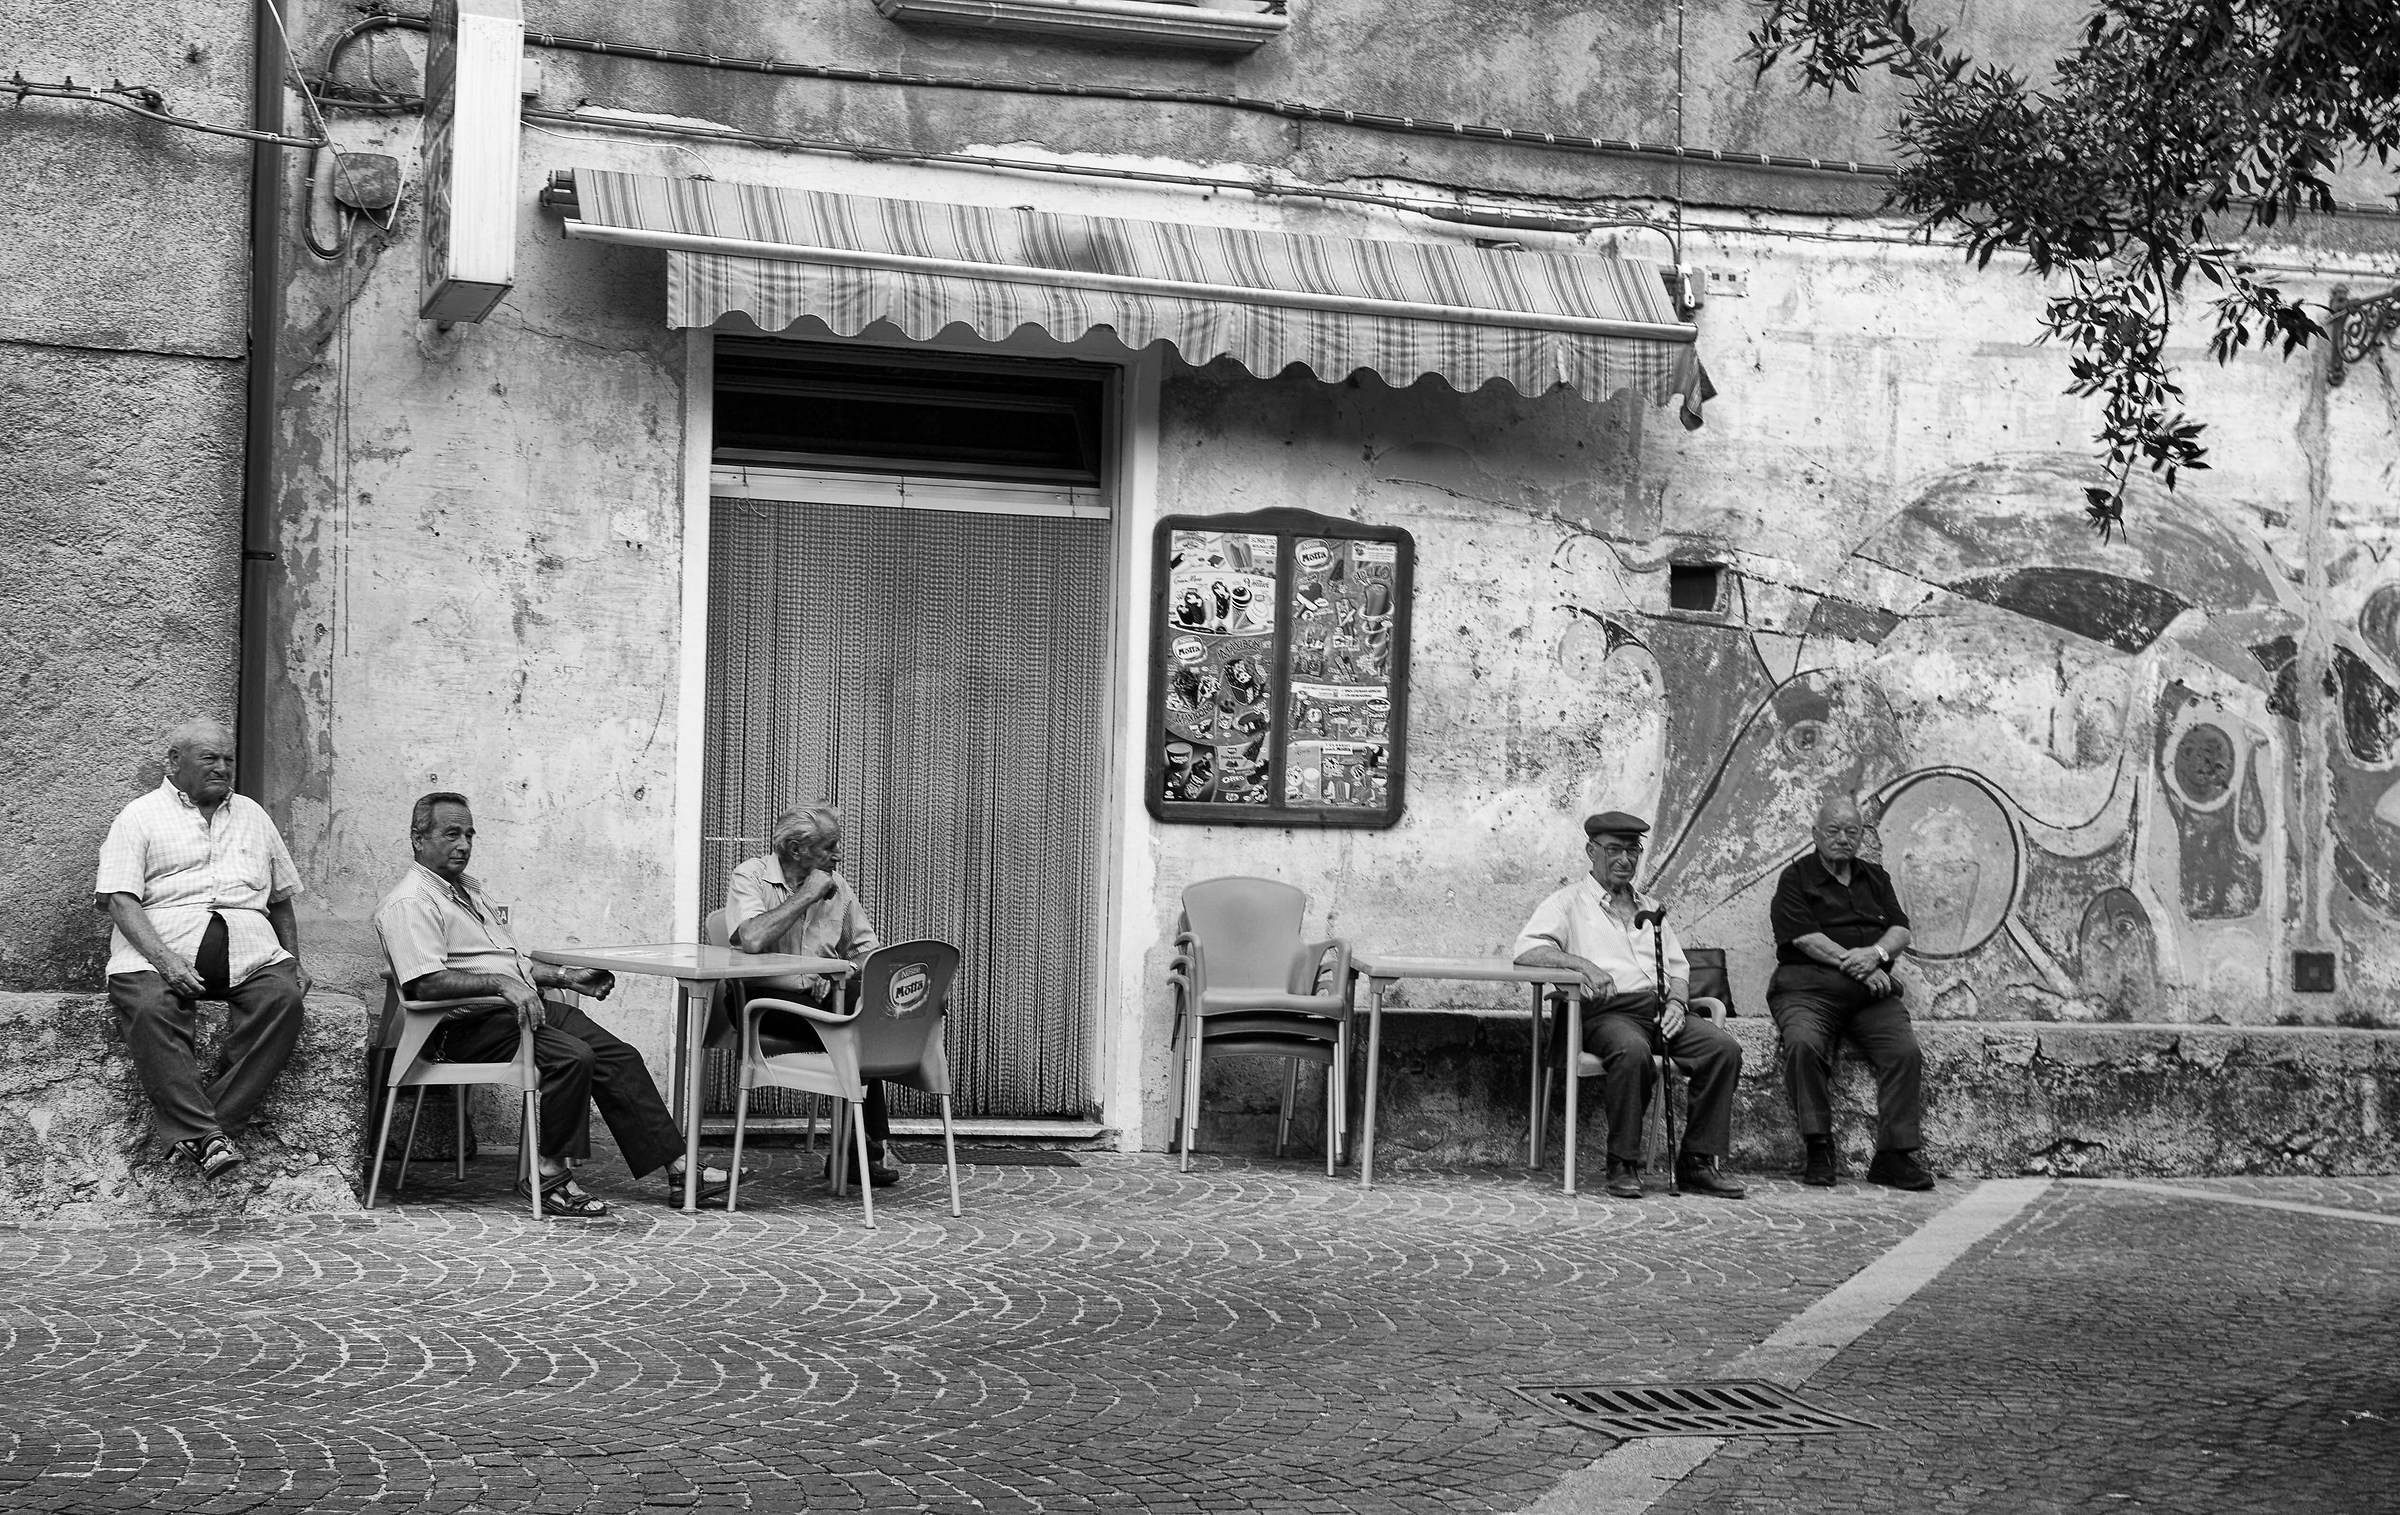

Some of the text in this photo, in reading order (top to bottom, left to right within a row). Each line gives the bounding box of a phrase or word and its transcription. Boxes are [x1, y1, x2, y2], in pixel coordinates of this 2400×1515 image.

[1301, 551, 1327, 562] Motta
[1178, 646, 1201, 656] Motta
[1221, 775, 1245, 784] OREO
[895, 980, 924, 999] Motta
